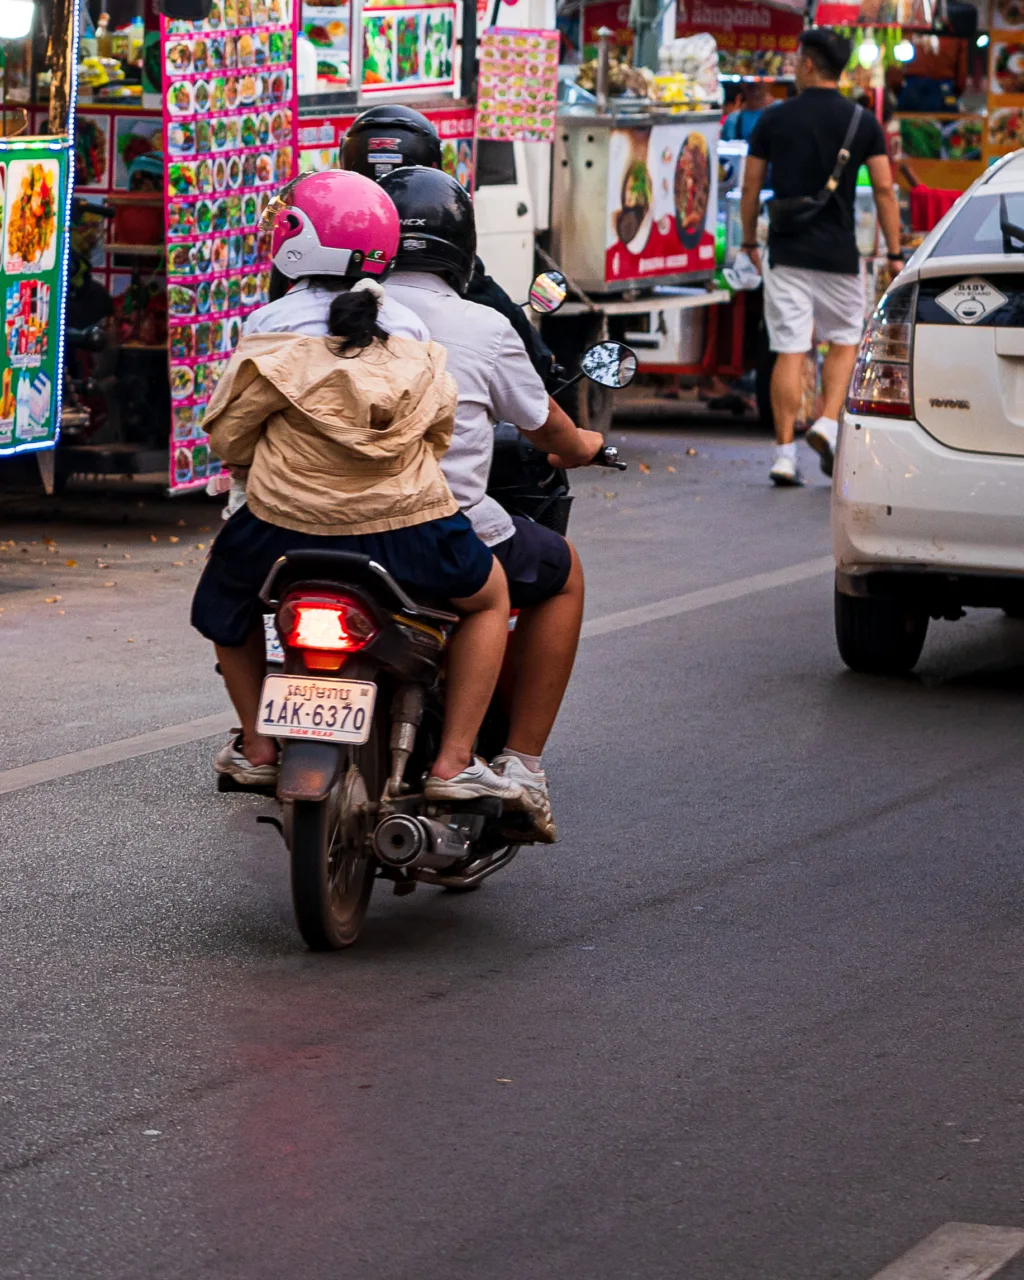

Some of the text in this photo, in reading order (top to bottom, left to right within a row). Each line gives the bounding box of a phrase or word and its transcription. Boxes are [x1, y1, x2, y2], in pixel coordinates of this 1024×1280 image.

[958, 284, 986, 292] BABY
[929, 398, 971, 410] TOYOTA
[263, 698, 366, 732] 1AK-6370
[289, 728, 334, 738] SIEM REAP
